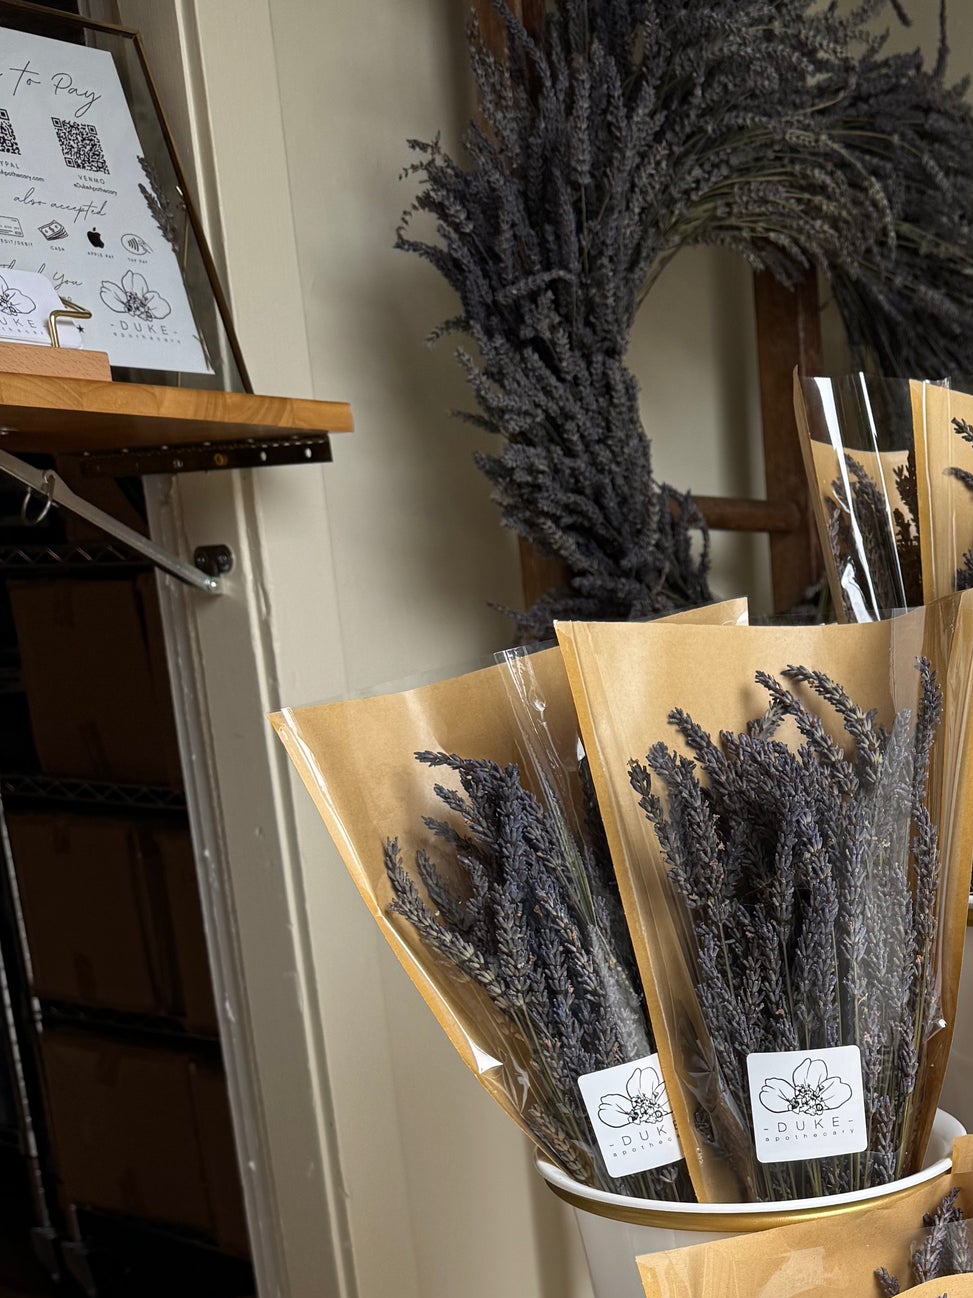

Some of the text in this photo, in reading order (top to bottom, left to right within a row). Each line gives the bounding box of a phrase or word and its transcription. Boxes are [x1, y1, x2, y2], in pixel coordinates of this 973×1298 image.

[51, 72, 102, 118] Pay
[77, 174, 106, 185] VENMO
[13, 187, 108, 224] also accepted
[53, 272, 83, 291] You
[765, 1128, 855, 1142] apothecary
[612, 1136, 673, 1158] apothec
